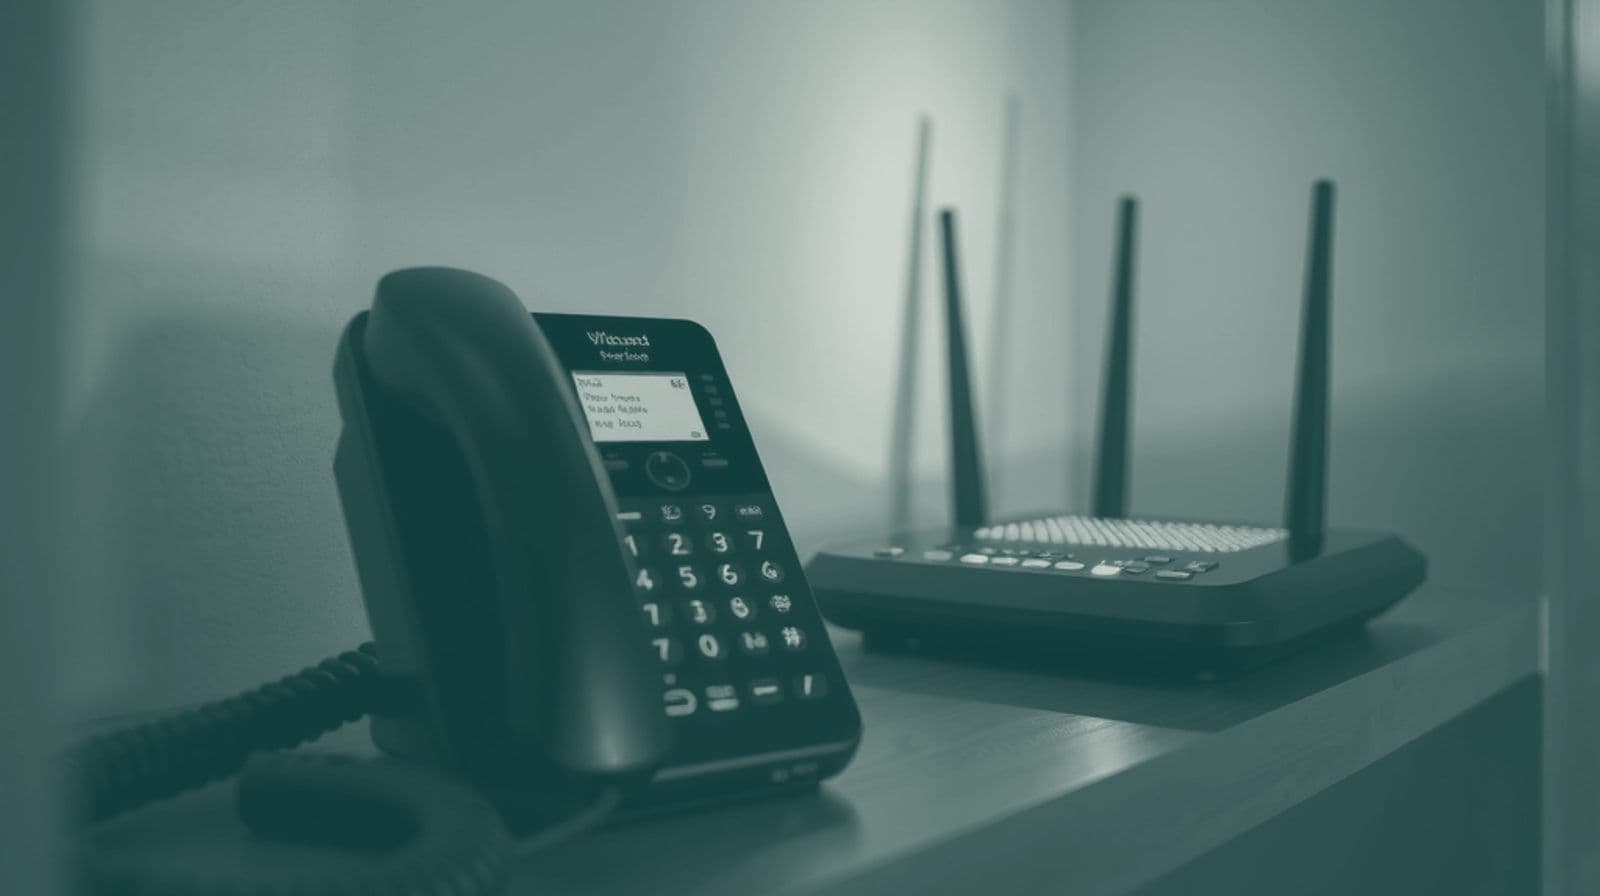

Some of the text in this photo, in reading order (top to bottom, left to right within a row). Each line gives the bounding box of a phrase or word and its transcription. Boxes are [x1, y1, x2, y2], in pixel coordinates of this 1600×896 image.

[668, 533, 689, 555] 2
[712, 532, 728, 552] 3
[636, 568, 653, 590] 4
[678, 566, 697, 588] 5
[722, 564, 738, 585] 6
[698, 634, 719, 658] 0
